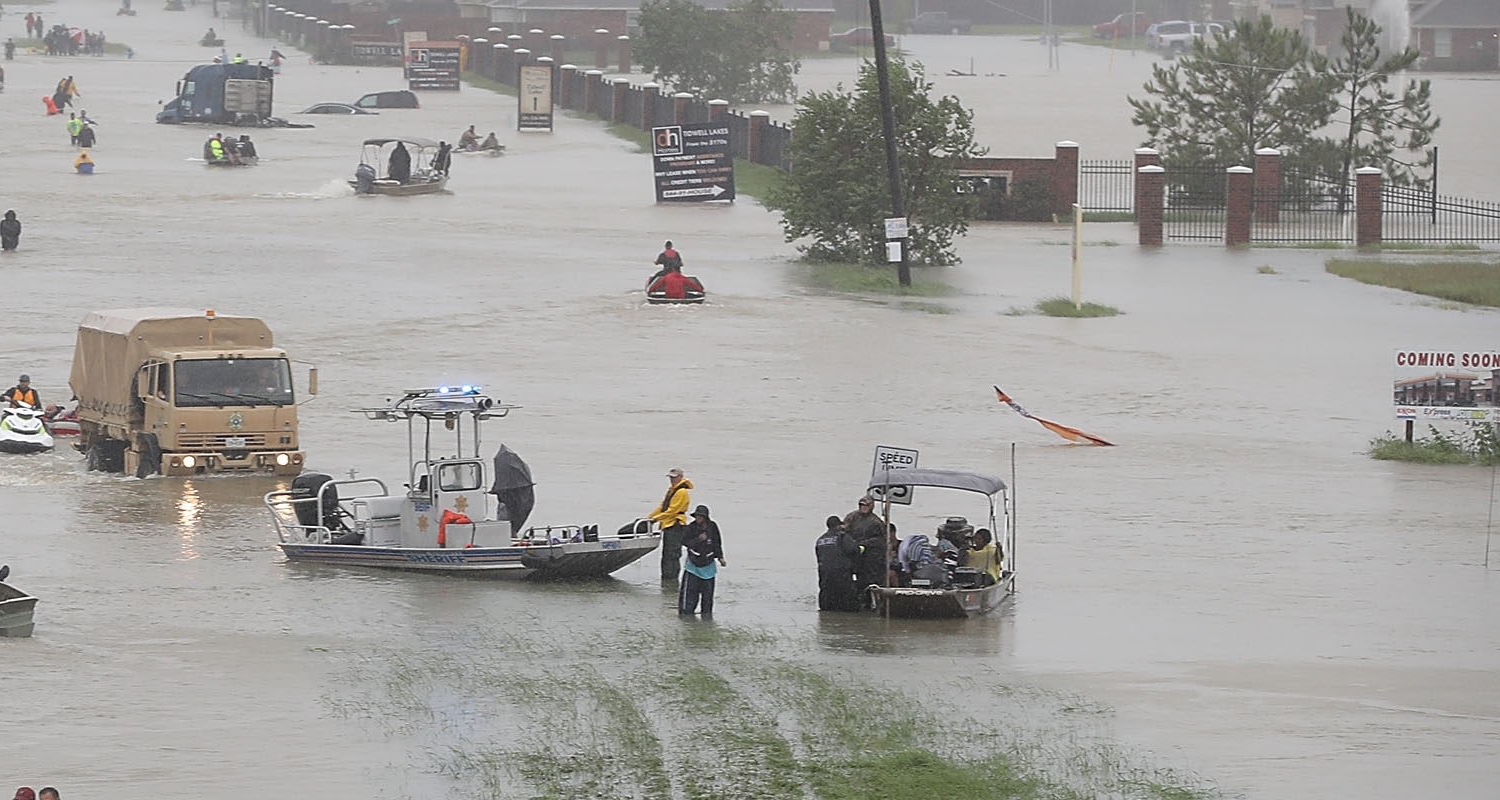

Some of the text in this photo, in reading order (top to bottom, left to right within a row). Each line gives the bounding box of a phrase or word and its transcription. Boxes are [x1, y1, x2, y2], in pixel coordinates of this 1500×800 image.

[1397, 352, 1500, 368] COMING SOON
[879, 452, 914, 465] SPEED
[408, 554, 467, 564] SHERIFF
